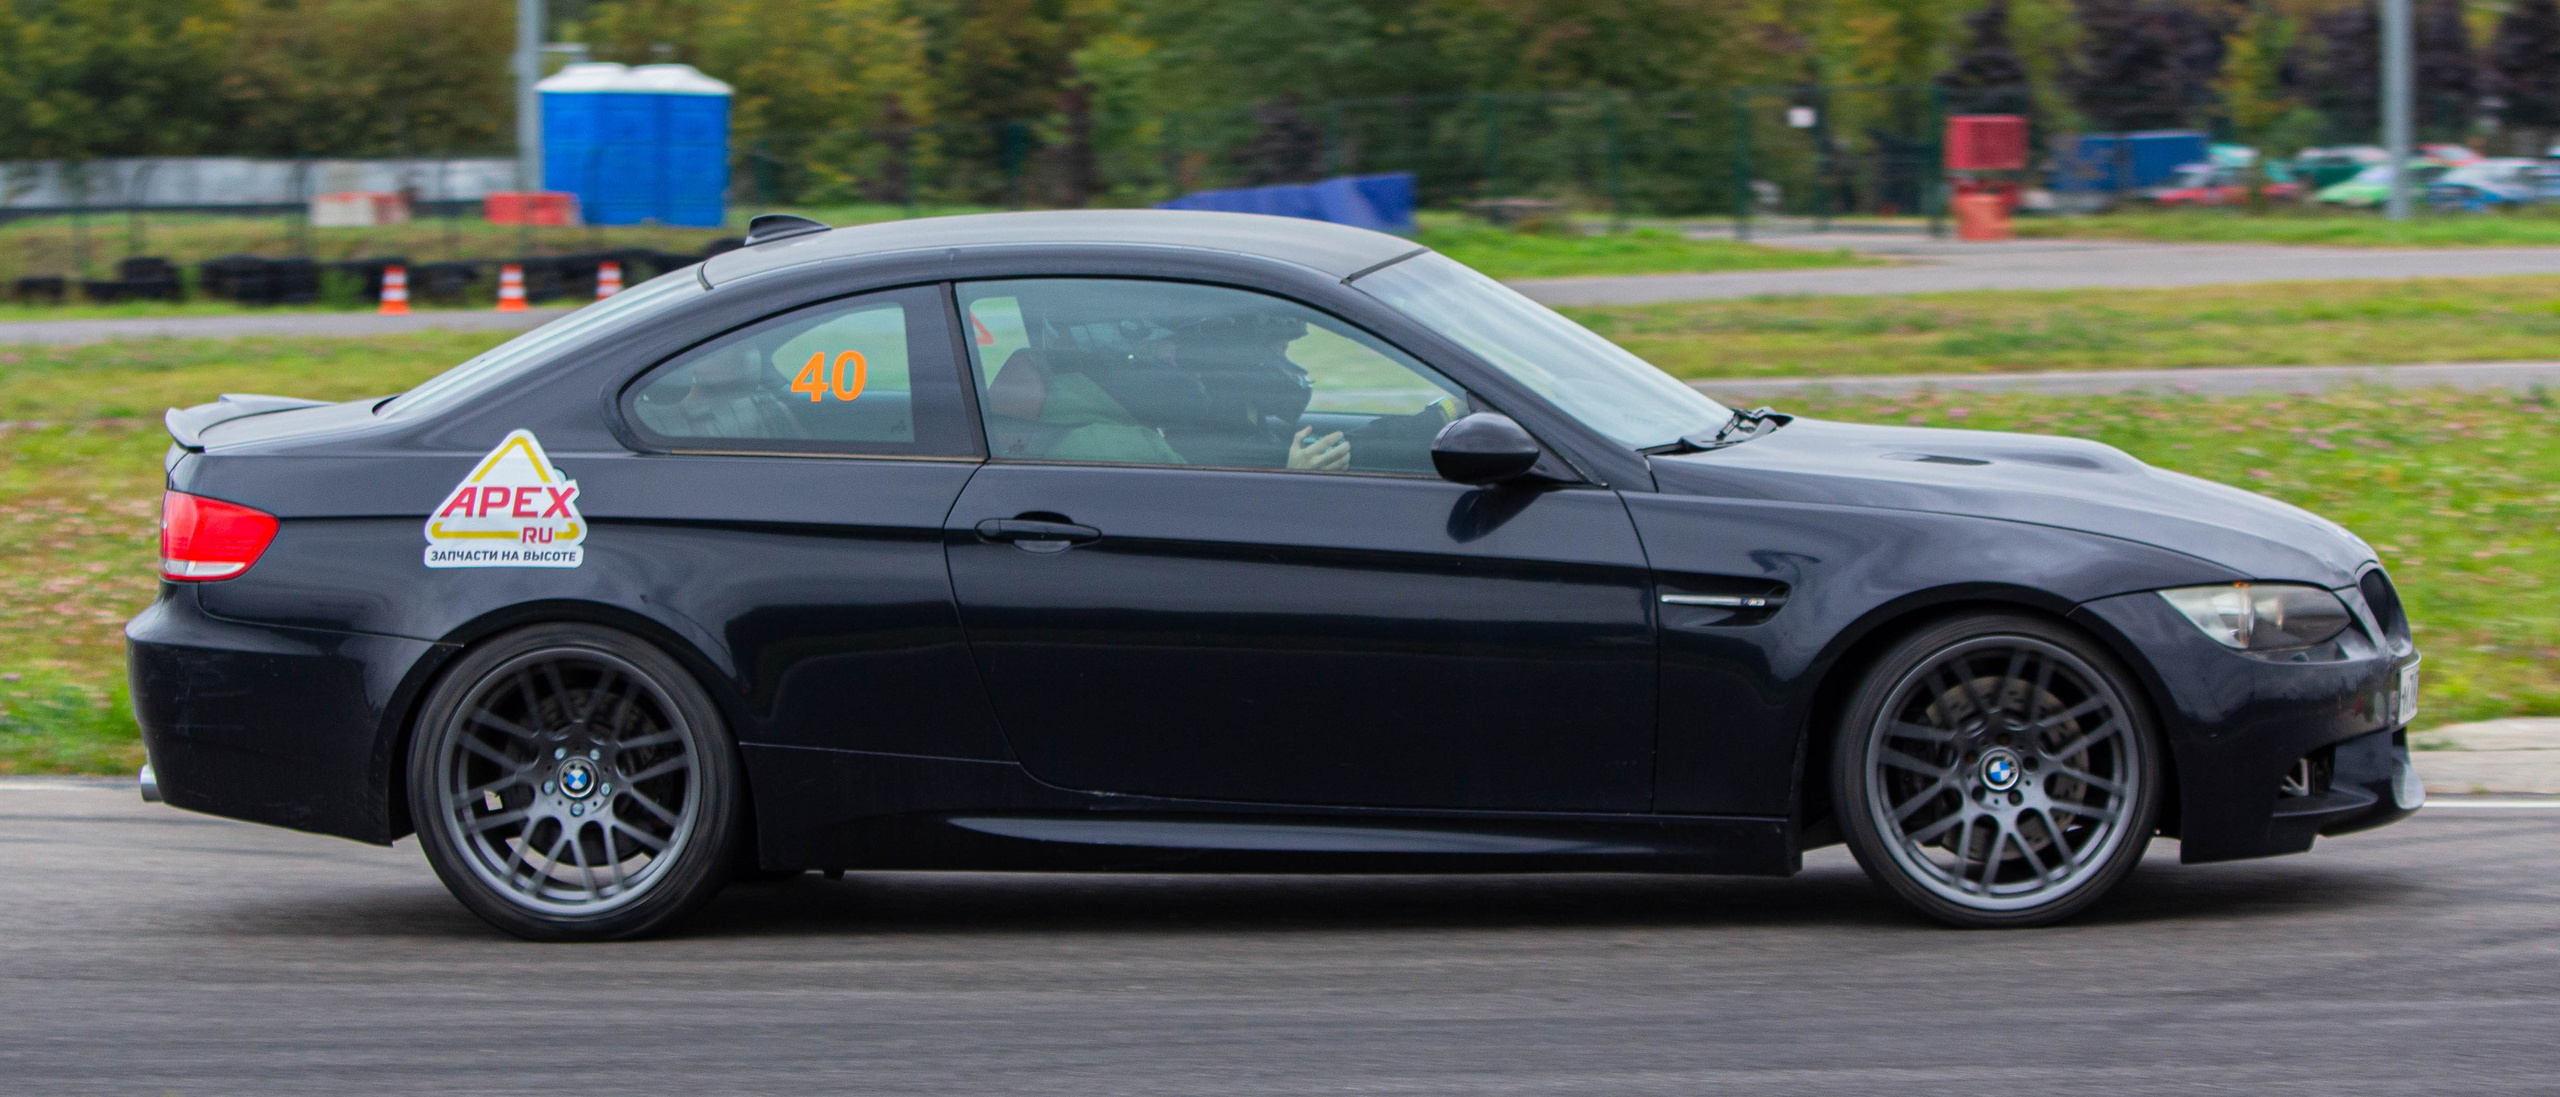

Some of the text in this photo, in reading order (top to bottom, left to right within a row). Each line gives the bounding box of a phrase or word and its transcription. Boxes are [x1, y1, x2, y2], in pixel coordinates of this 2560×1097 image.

[792, 350, 866, 402] 40
[439, 486, 576, 518] APEX
[522, 527, 553, 544] RU
[431, 551, 577, 562] ЗАПЧАСТИ НА ВЫСОТЕ
